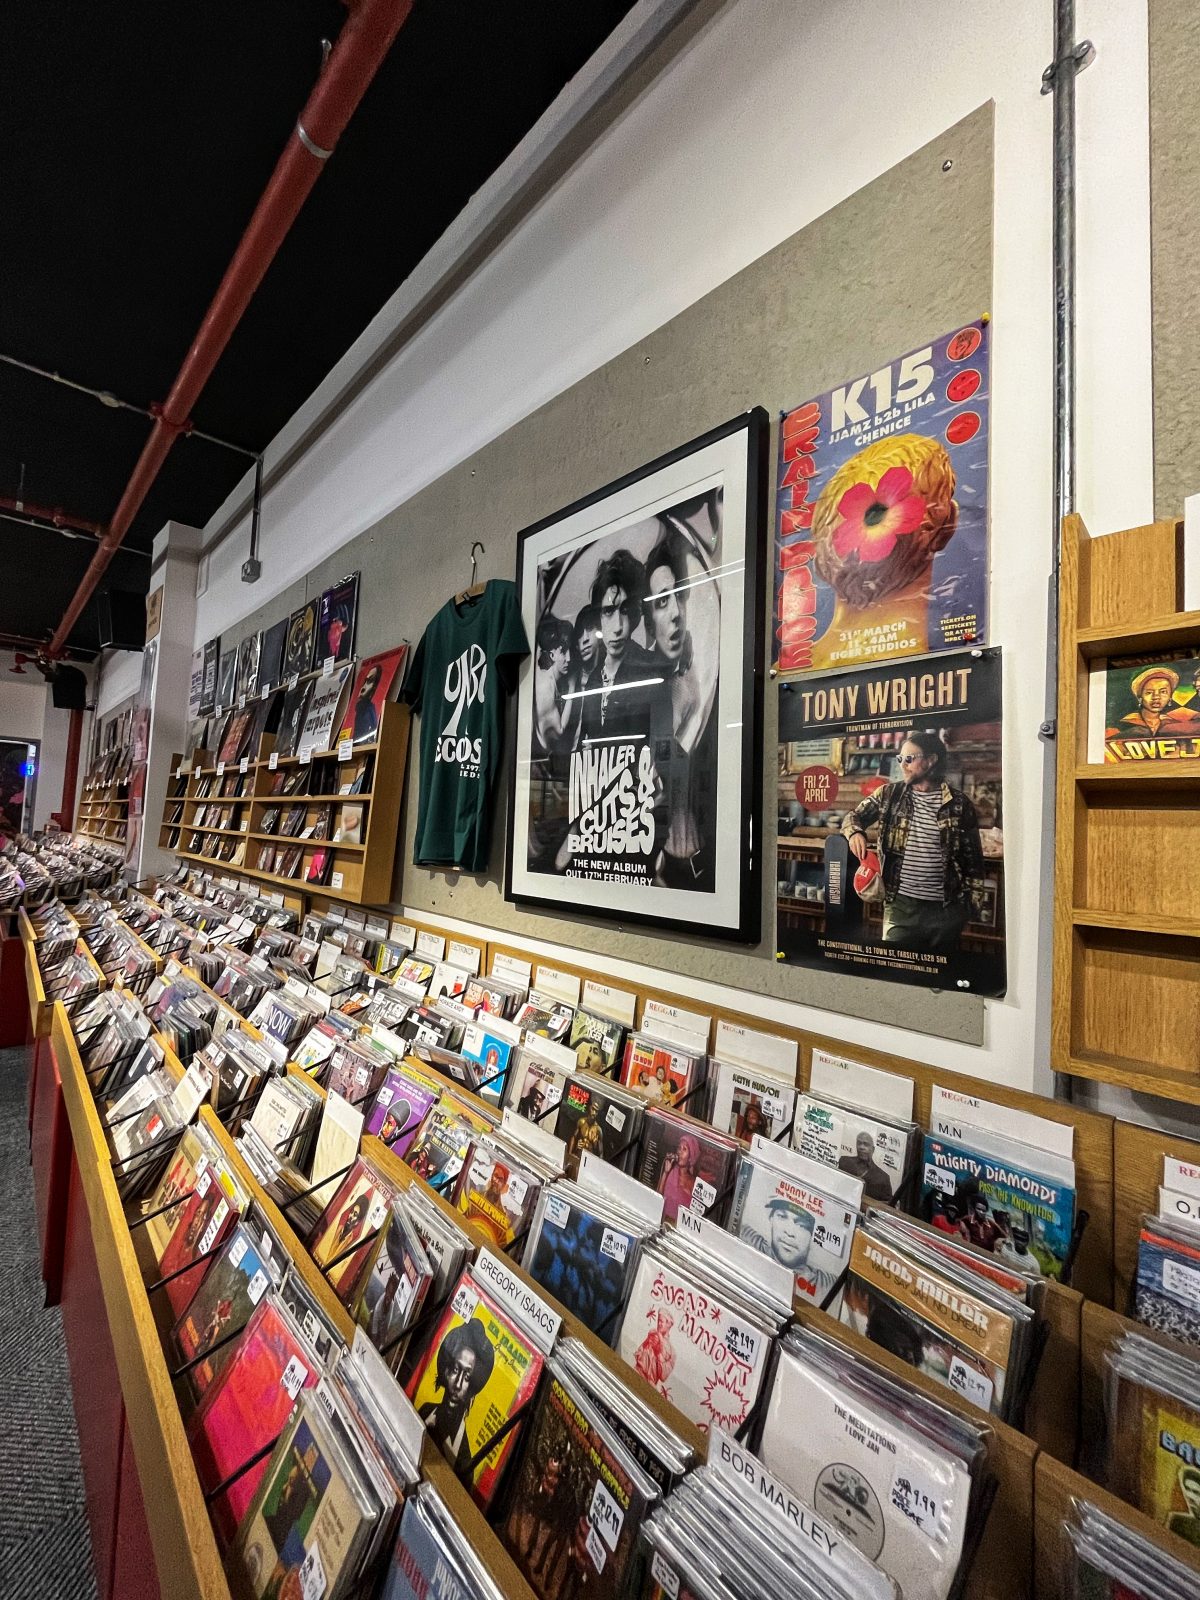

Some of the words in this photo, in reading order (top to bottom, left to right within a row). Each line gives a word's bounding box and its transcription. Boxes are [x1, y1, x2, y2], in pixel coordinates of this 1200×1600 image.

[831, 346, 934, 432] K15
[828, 419, 872, 445] JJAMZ
[874, 407, 901, 427] b2b
[904, 392, 936, 413] LILA
[854, 415, 911, 446] CHENICE
[863, 621, 907, 637] MARCH
[940, 616, 965, 625] TICKETS
[870, 632, 897, 644] 4AM
[831, 648, 862, 661] EIGER
[864, 638, 917, 655] STUDIOS
[801, 685, 860, 722] TONY
[867, 668, 972, 716] WRIGHT
[569, 745, 635, 824] INHALER
[580, 768, 635, 834] CUTS
[638, 744, 656, 803] &
[803, 775, 816, 789] FRI
[818, 774, 831, 788] 21
[805, 788, 829, 802] APRIL
[567, 795, 656, 856] BRUISES
[573, 858, 589, 868] THE
[591, 860, 611, 870] NEW
[613, 861, 647, 874] ALBUM
[565, 869, 582, 879] OUT
[604, 873, 653, 887] FEBRUARY
[865, 946, 873, 954] 51
[873, 947, 888, 956] TOWN
[538, 968, 558, 979] REGGAE
[587, 982, 610, 996] REGGAE
[649, 1002, 678, 1017] REGGAE
[268, 1004, 292, 1036] NOW
[643, 1020, 649, 1028] G
[722, 1024, 746, 1036] REGGAE
[819, 1056, 849, 1070] REGGAE
[752, 1080, 780, 1099] HUDSON
[941, 1090, 981, 1109] REGGAE
[757, 1139, 763, 1149] L
[779, 1180, 807, 1201] BUNNY
[808, 1192, 824, 1209] LEE
[979, 1180, 994, 1196] PASS
[826, 1231, 841, 1247] 11.99
[480, 1257, 521, 1300] GREGORY
[520, 1294, 555, 1334] ISAACS
[651, 1279, 709, 1318] SUGAR
[871, 1260, 892, 1280] WHO
[893, 1276, 910, 1290] SAY
[911, 1287, 929, 1305] JAH
[933, 1300, 948, 1316] NO
[951, 1310, 987, 1339] DREAD
[678, 1311, 752, 1388] MINOTT
[740, 1332, 755, 1354] 9.99
[834, 1403, 847, 1420] THE
[848, 1414, 897, 1455] MEDITATIONS
[848, 1427, 866, 1445] LOVE
[866, 1441, 880, 1455] JAH
[721, 1442, 755, 1484] BOB
[760, 1477, 838, 1556] MARLEY
[913, 1489, 936, 1518] 9.99
